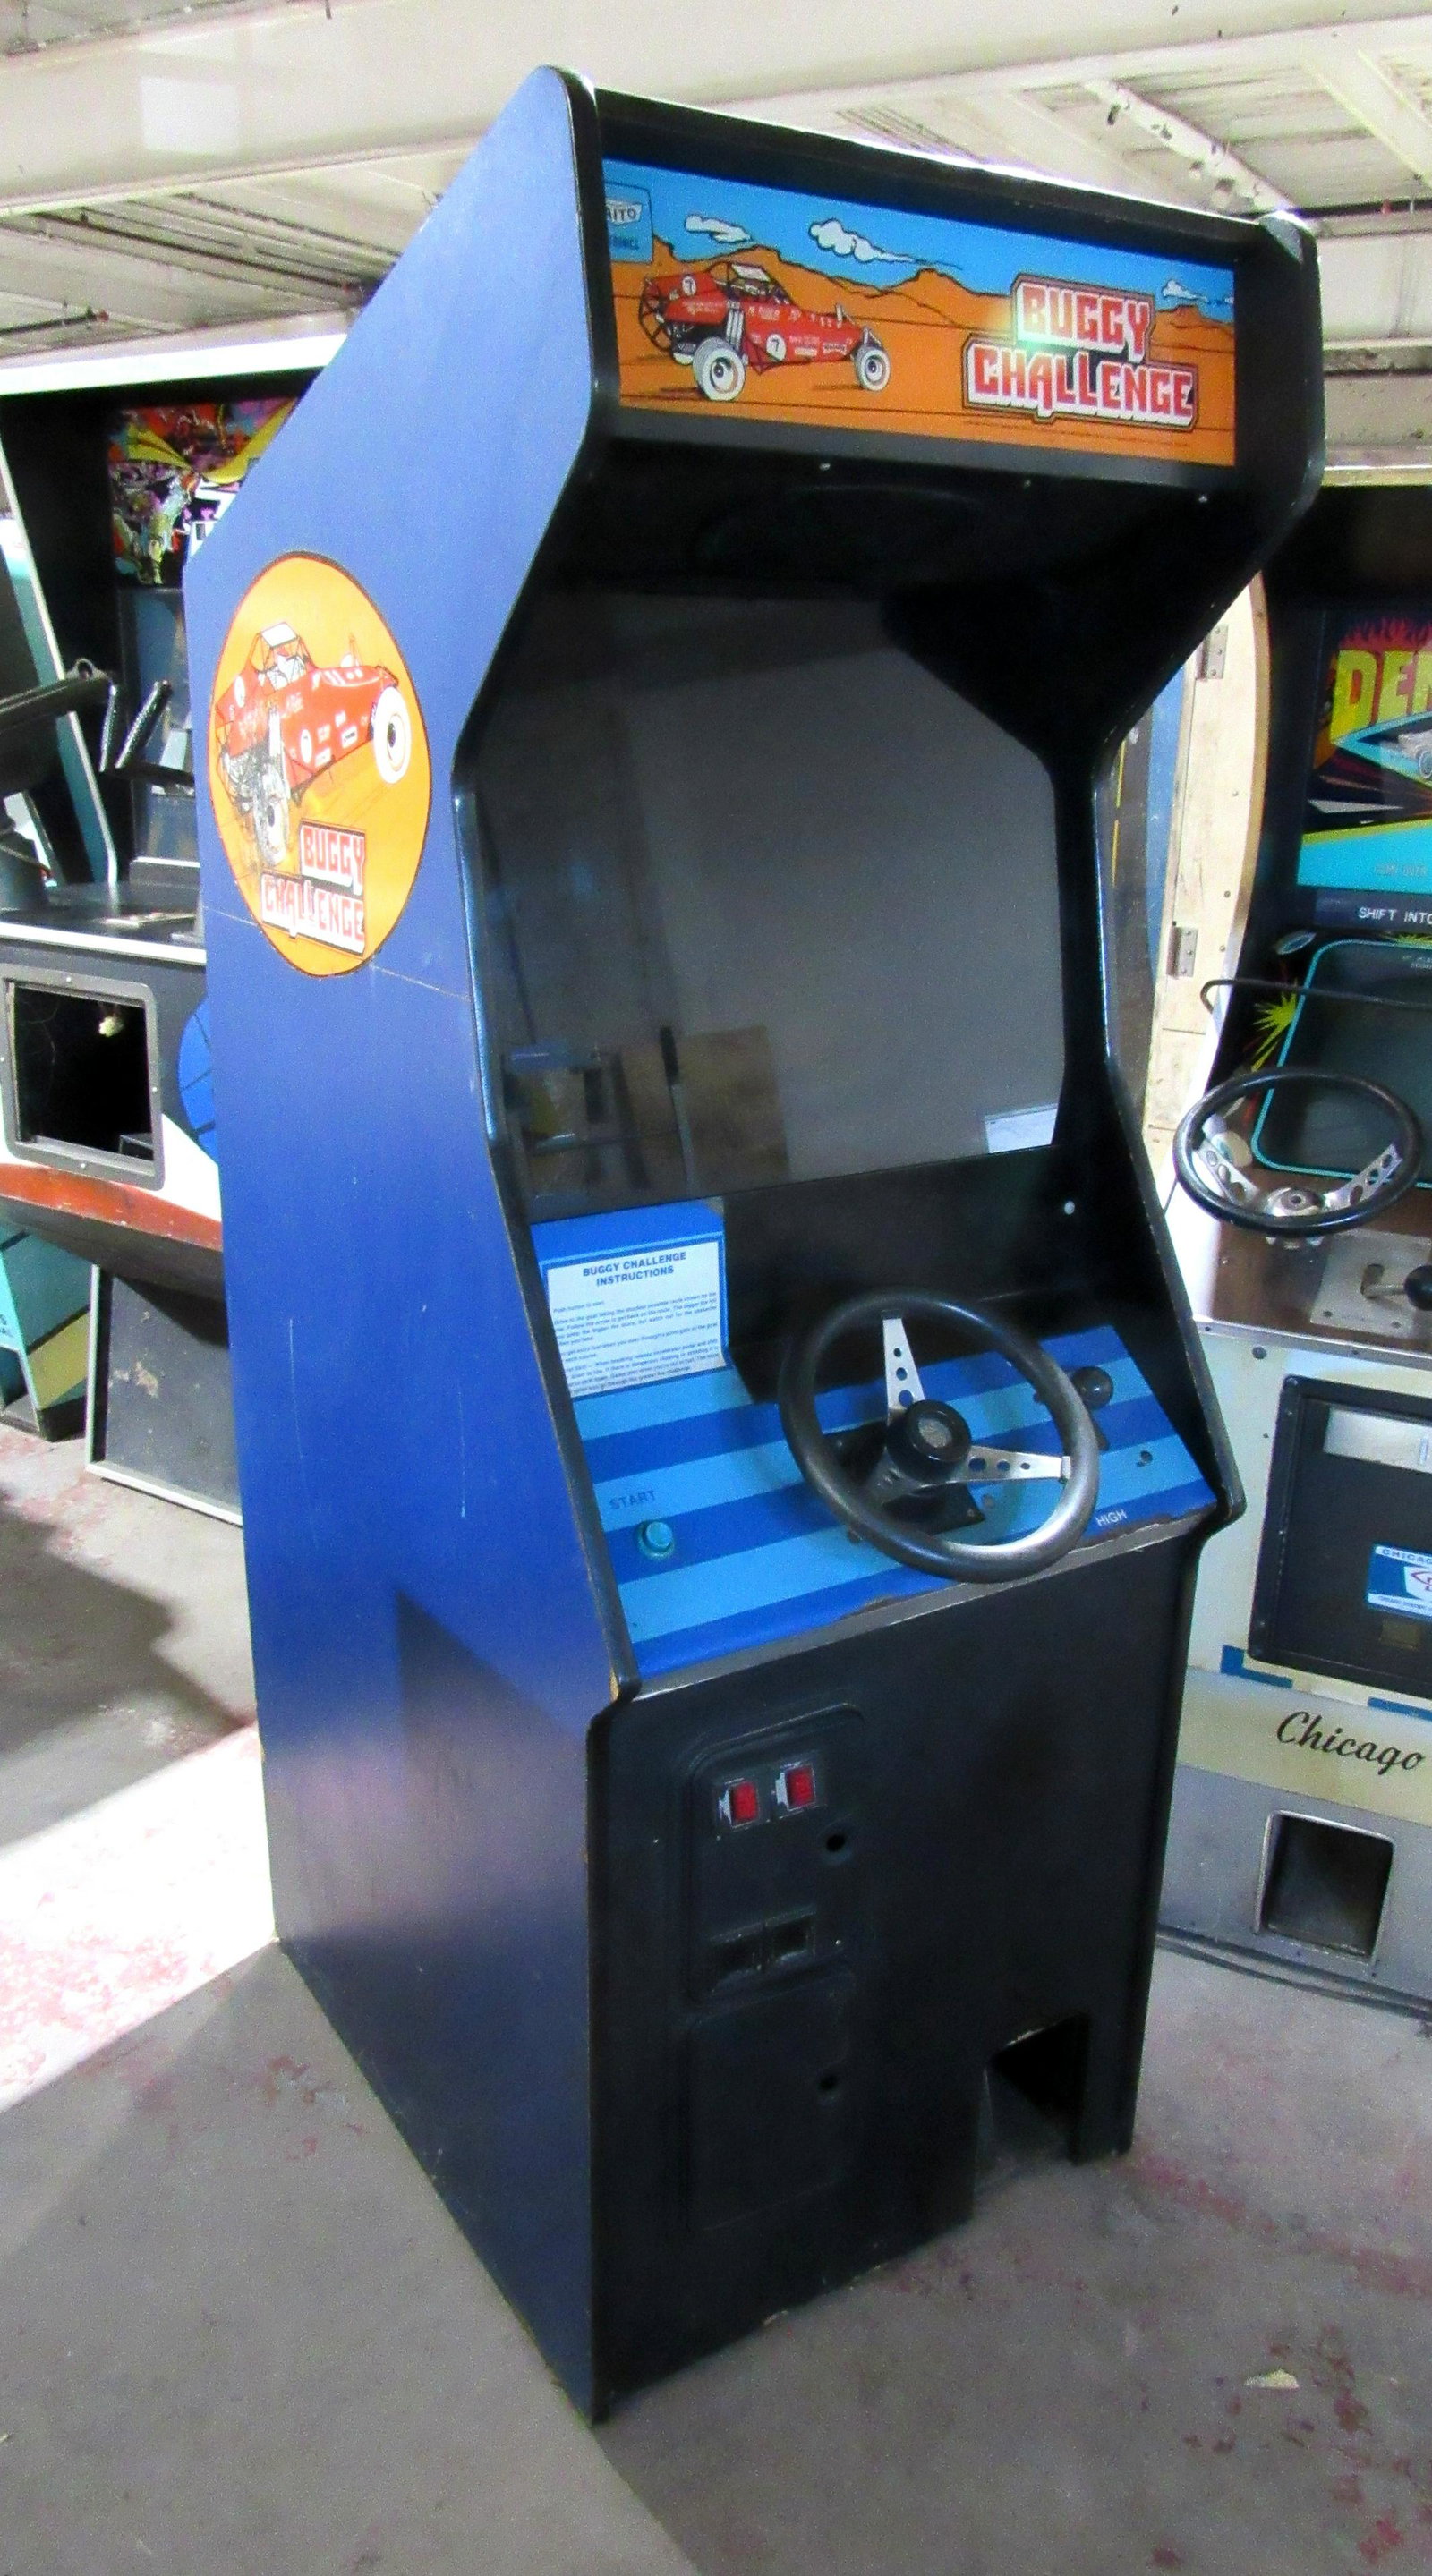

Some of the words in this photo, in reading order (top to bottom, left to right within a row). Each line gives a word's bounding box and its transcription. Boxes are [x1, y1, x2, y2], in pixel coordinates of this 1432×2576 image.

[1019, 283, 1150, 360] BUGGY
[969, 344, 1194, 424] CHALLENGE
[301, 826, 364, 894] BUGGY
[263, 874, 364, 950] CHALLENGE
[1358, 906, 1398, 921] SHIFT
[583, 1262, 619, 1277] BUGGY
[623, 1252, 686, 1271] CHALLENGE
[596, 1265, 674, 1287] INSTRUCTIONS
[609, 1490, 656, 1510] START
[1095, 1509, 1128, 1527] HIGH
[1277, 1711, 1425, 1775] Chicago
